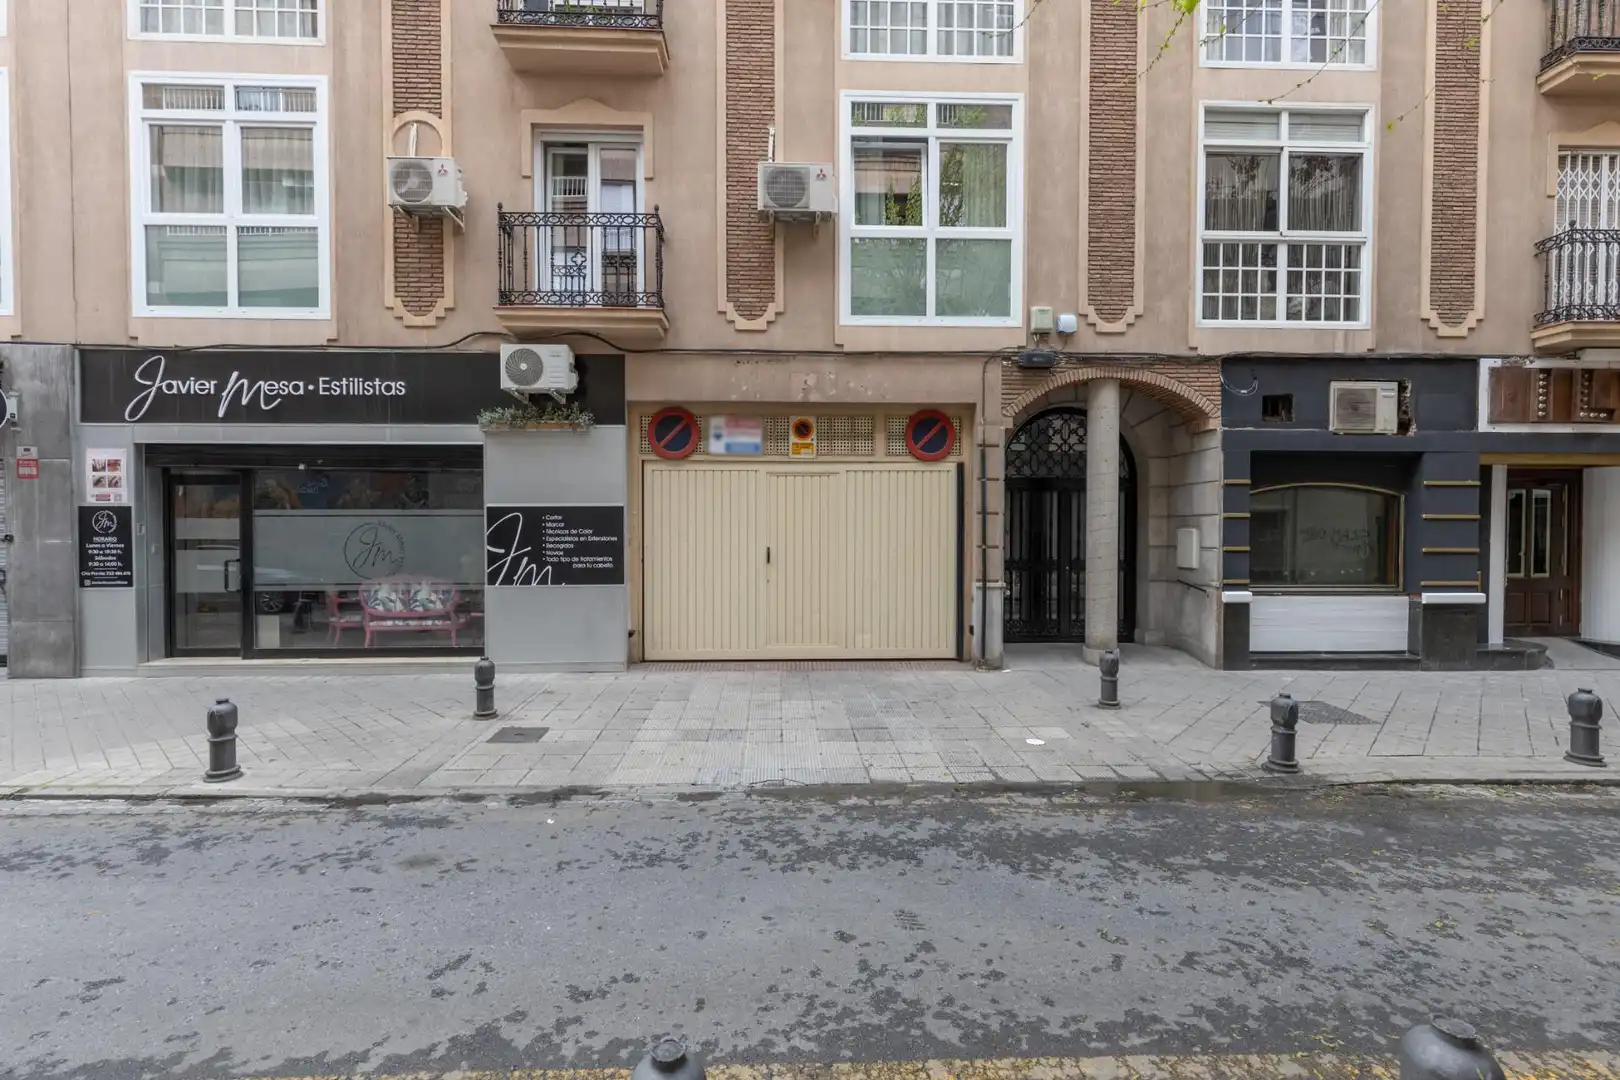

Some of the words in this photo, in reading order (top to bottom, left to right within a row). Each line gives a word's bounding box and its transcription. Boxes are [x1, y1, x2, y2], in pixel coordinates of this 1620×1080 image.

[124, 355, 217, 422] Javier
[218, 371, 304, 418] Mesa
[318, 376, 406, 397] Estilistas
